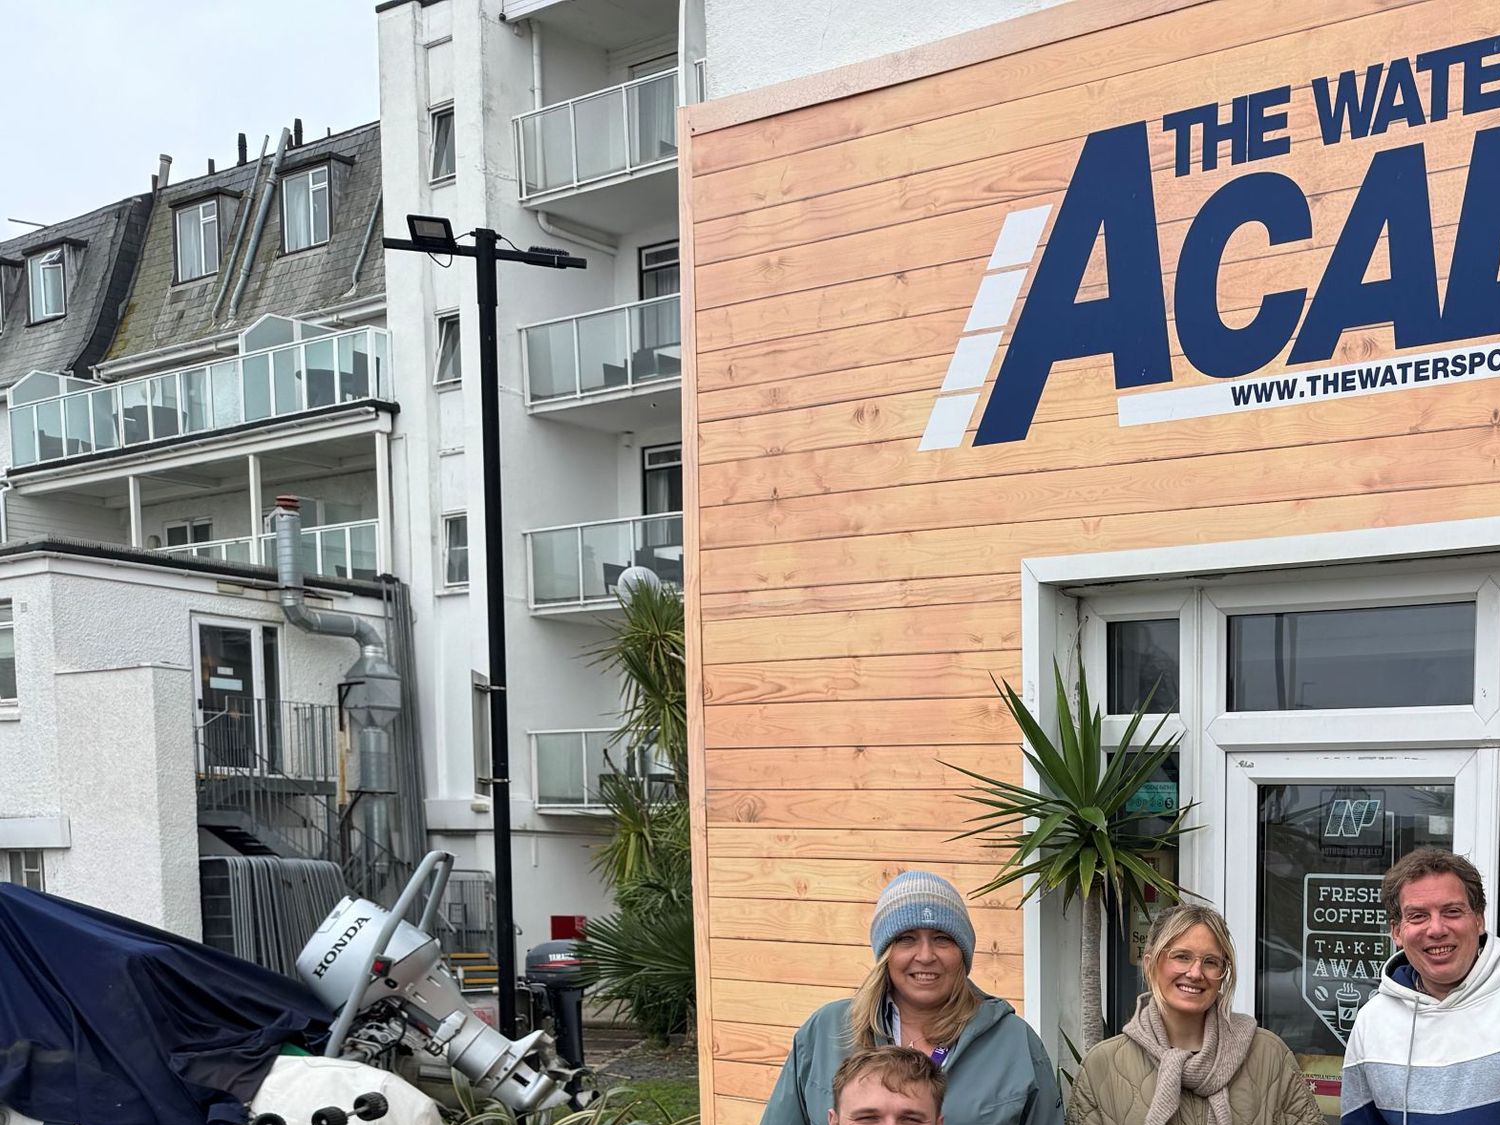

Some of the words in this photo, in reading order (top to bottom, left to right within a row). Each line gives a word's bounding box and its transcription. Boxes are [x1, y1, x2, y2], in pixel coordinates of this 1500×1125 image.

[1163, 86, 1291, 177] THE
[1319, 886, 1382, 903] FRESH
[1313, 907, 1387, 925] COFFEE
[312, 916, 372, 979] HONDA
[1312, 957, 1386, 979] AWAY
